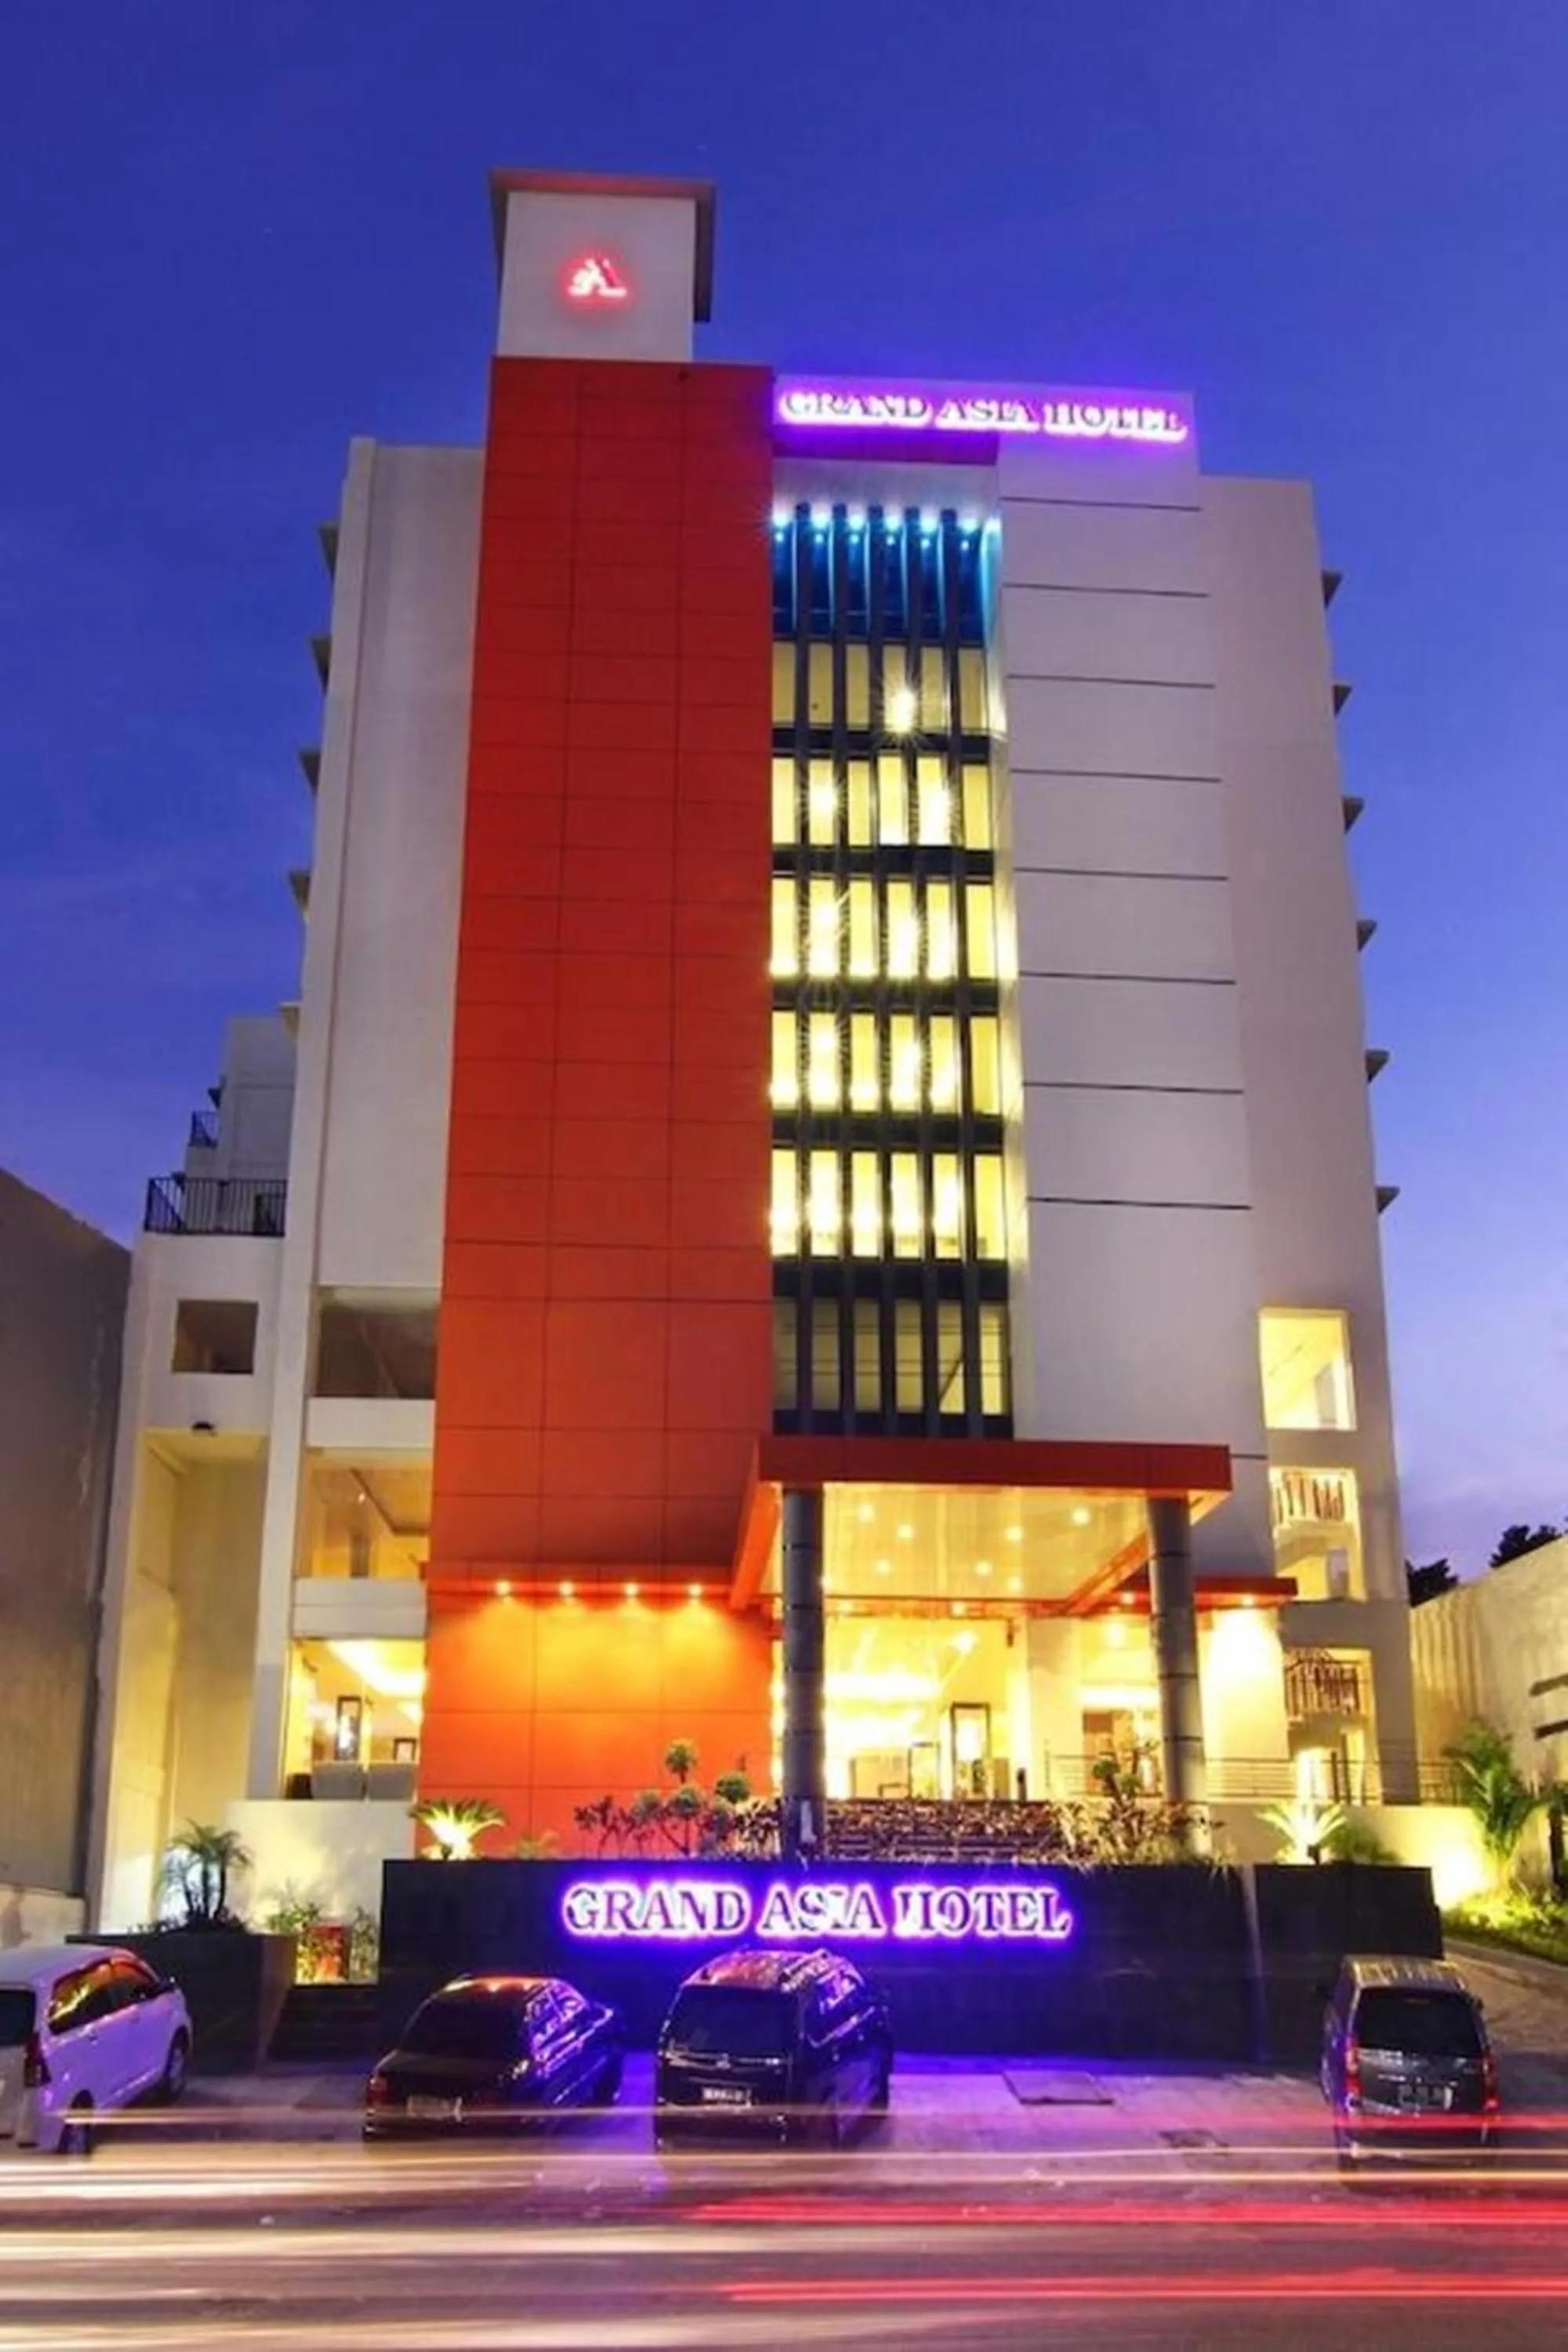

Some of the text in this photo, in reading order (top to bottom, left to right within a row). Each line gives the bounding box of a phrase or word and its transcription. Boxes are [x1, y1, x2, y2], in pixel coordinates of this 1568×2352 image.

[782, 391, 1187, 440] GRAND ASIA HOTEL
[564, 1886, 1071, 1935] GRAND ASIA HOTEL
